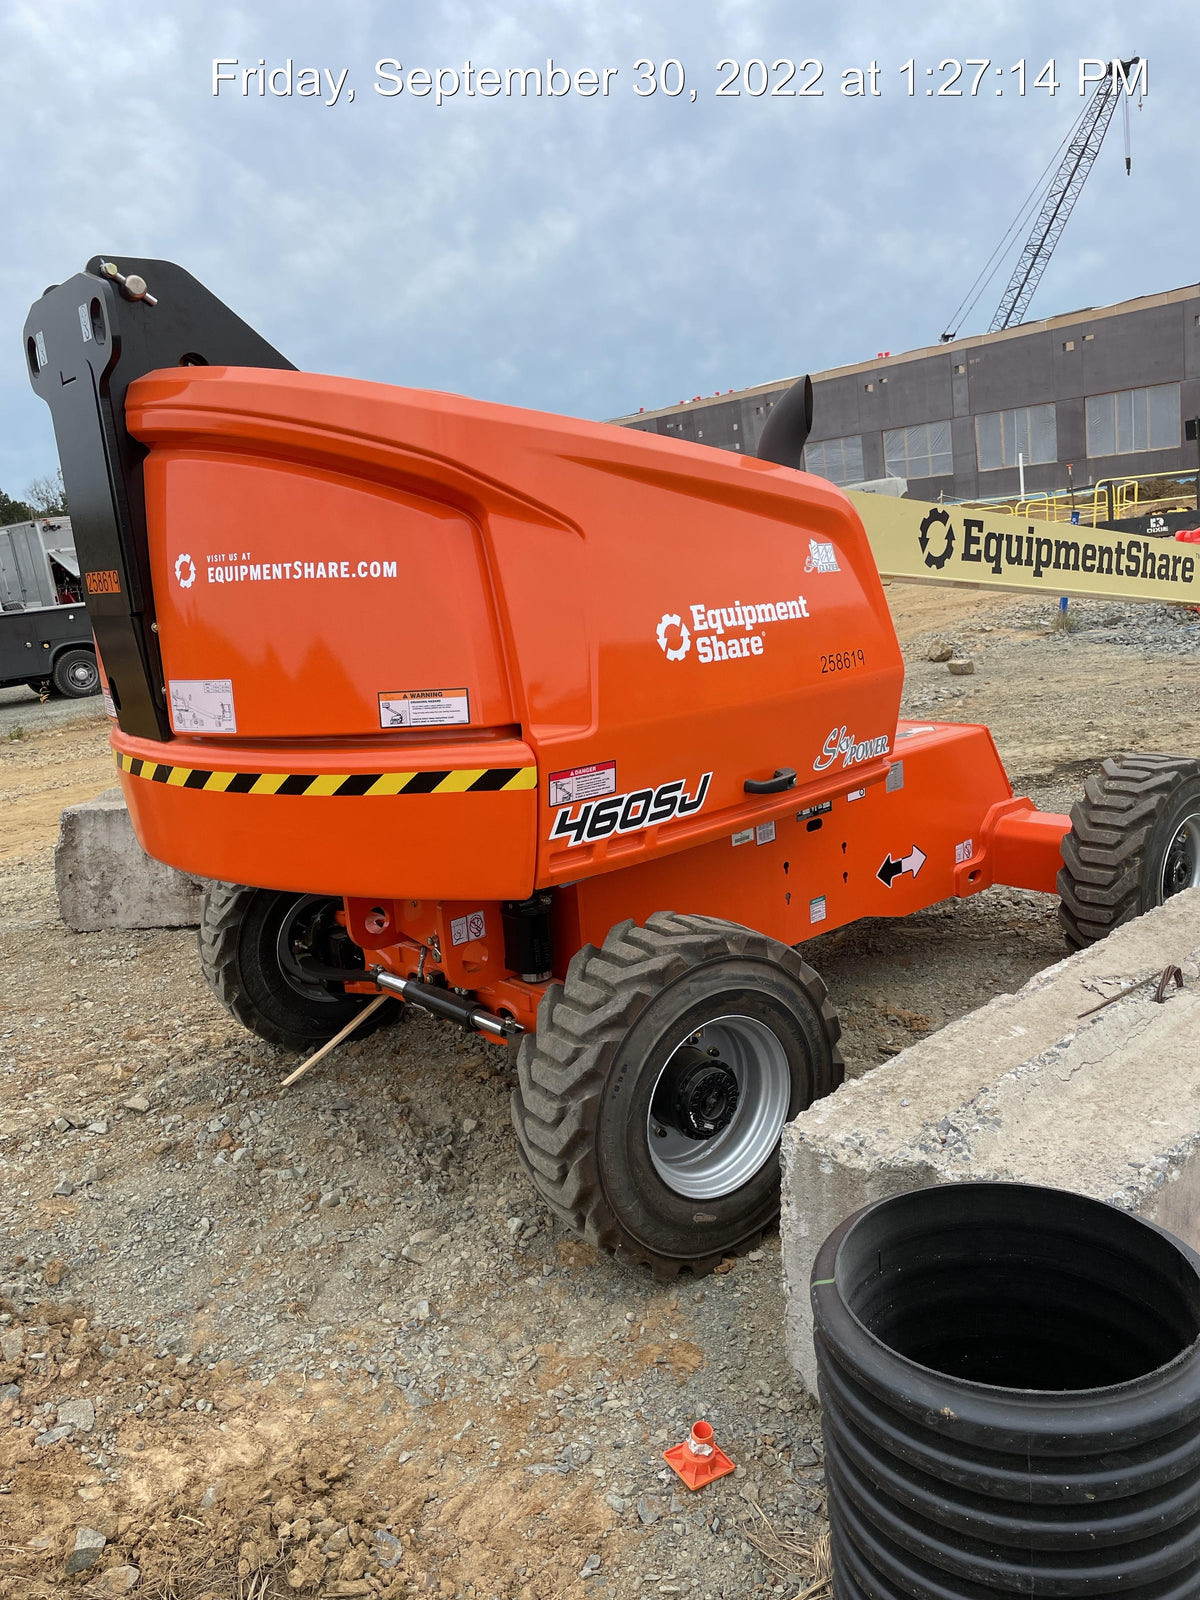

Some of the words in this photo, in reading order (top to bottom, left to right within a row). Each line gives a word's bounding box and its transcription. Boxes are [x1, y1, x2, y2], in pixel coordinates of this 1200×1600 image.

[1146, 526, 1169, 534] DIXIE
[206, 553, 226, 563] VISIT
[229, 553, 238, 562] US
[241, 552, 251, 561] AT
[961, 518, 1195, 583] EquipmentShare
[86, 570, 120, 593] 258619
[689, 595, 810, 634] Equipment
[820, 649, 866, 674] 258619
[410, 691, 443, 699] WARNING
[574, 766, 597, 775] DANGER
[548, 771, 713, 847] 460SJ
